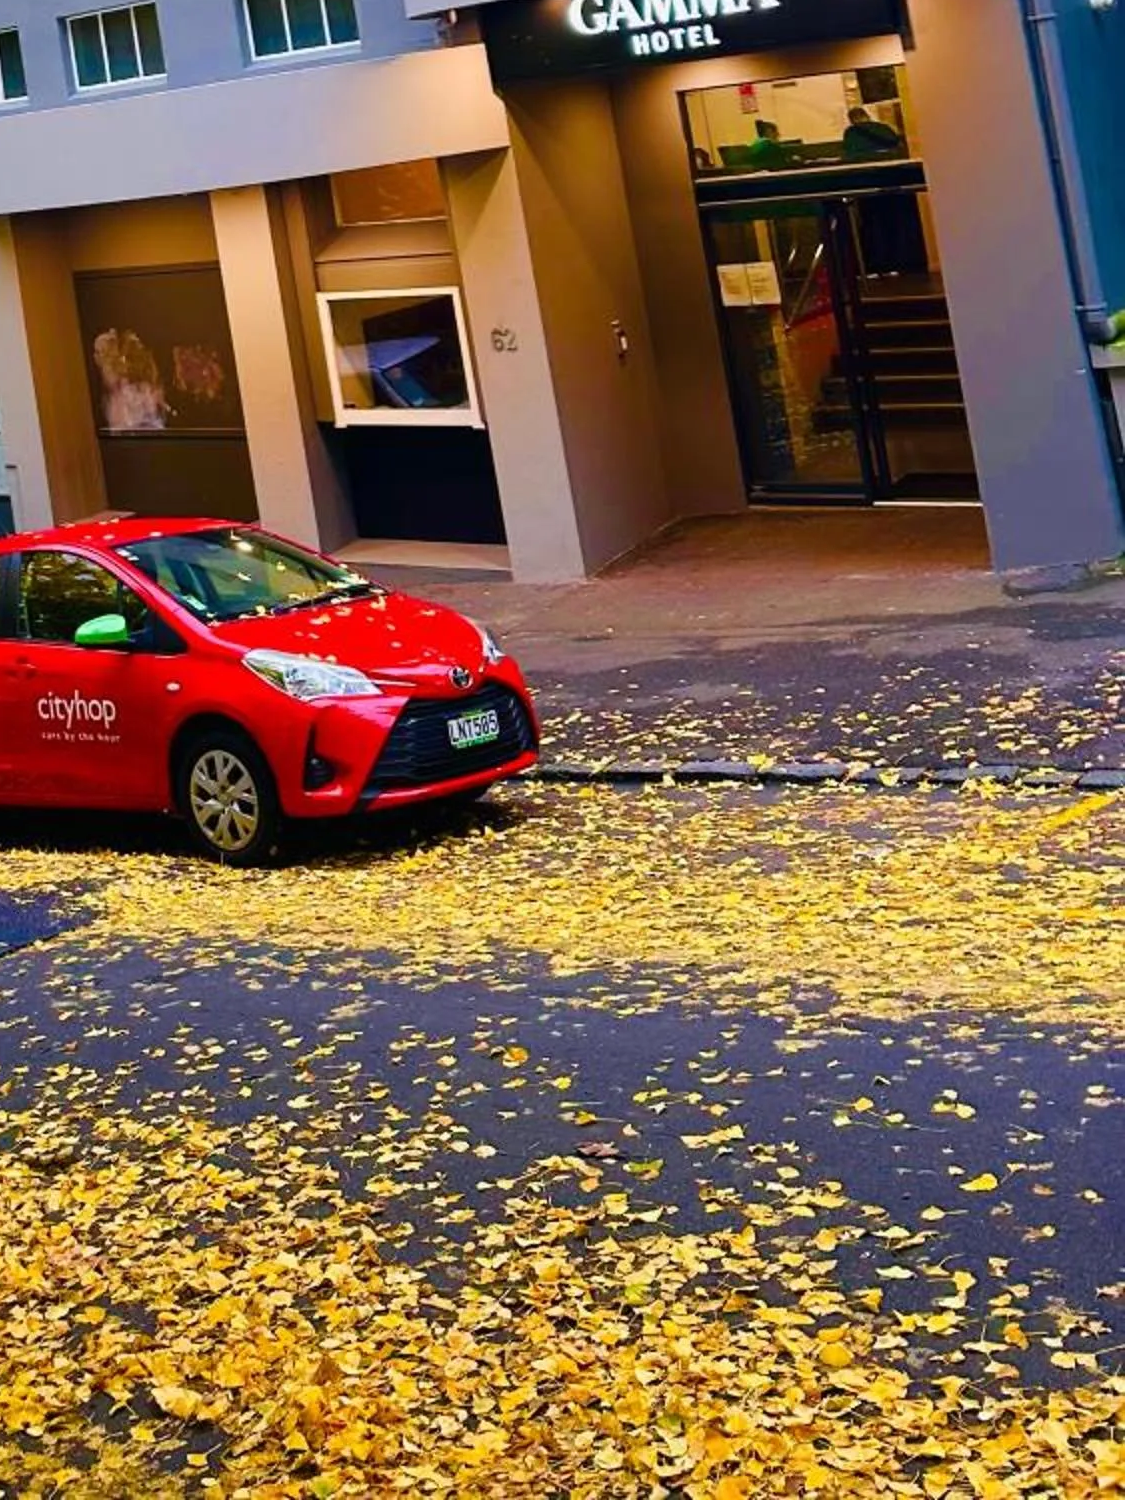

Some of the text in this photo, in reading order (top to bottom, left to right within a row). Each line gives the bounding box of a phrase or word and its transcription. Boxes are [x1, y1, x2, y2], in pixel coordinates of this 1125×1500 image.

[631, 23, 721, 55] HOTEL
[491, 328, 518, 352] 62
[37, 689, 117, 730] cityhop
